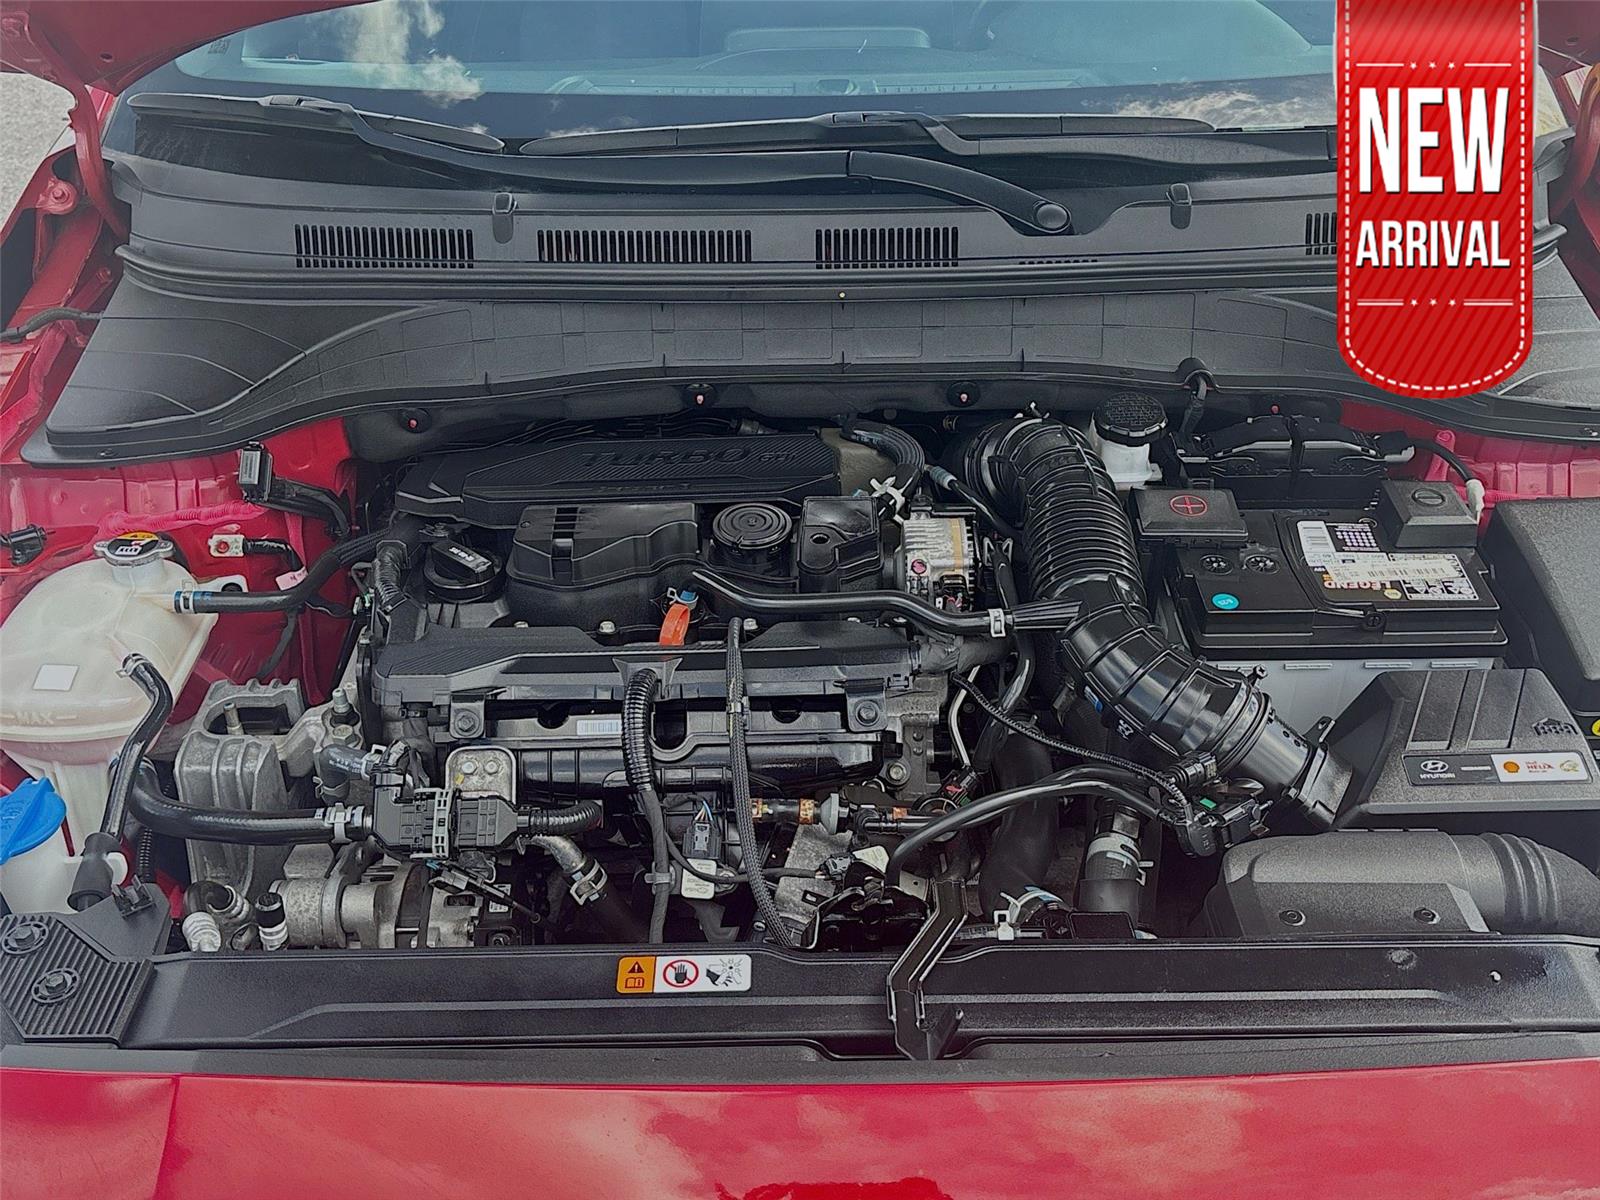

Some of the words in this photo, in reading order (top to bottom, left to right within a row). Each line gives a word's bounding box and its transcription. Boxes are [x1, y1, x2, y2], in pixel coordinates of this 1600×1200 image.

[582, 448, 751, 467] TURBO
[15, 711, 55, 726] MAX
[1419, 772, 1456, 780] HYUNDAI
